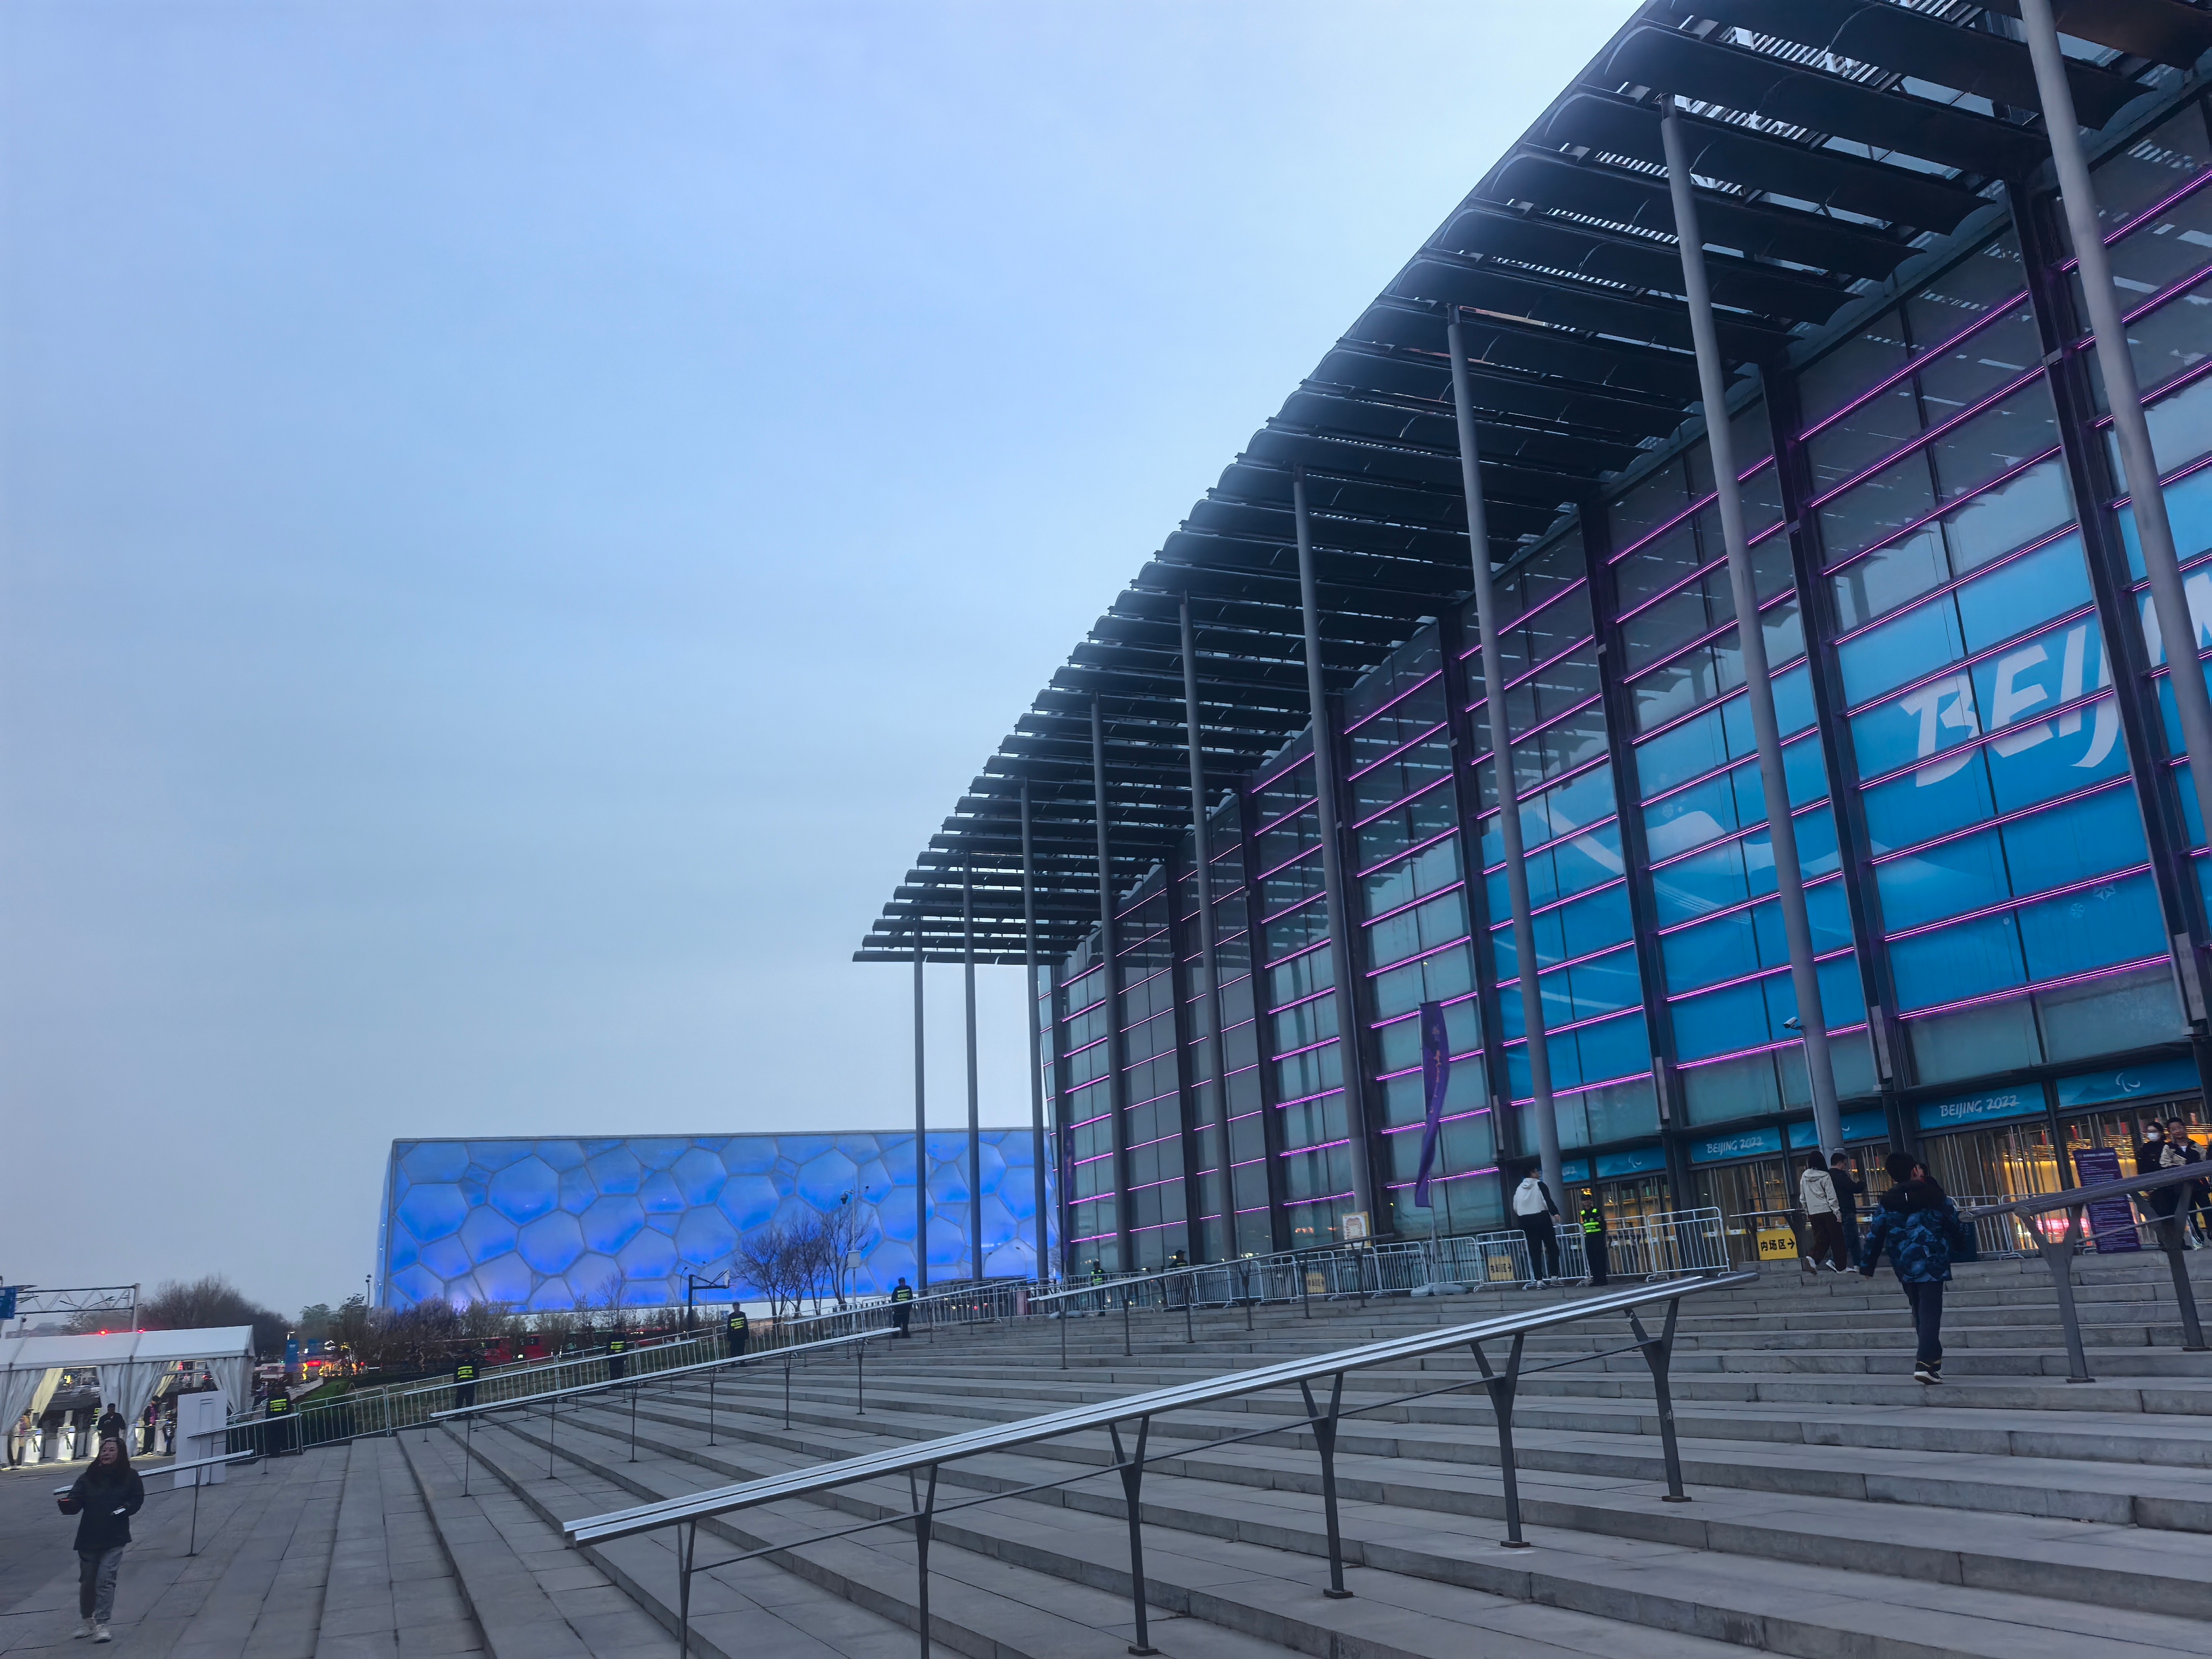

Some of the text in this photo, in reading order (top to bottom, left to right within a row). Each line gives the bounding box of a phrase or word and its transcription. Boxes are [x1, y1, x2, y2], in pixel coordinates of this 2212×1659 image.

[1939, 1095, 2021, 1118] BEIJING 2022
[1706, 1136, 1764, 1155] BEIJING 2022
[1562, 1166, 1577, 1176] 022
[1760, 1239, 1786, 1252] 内场区
